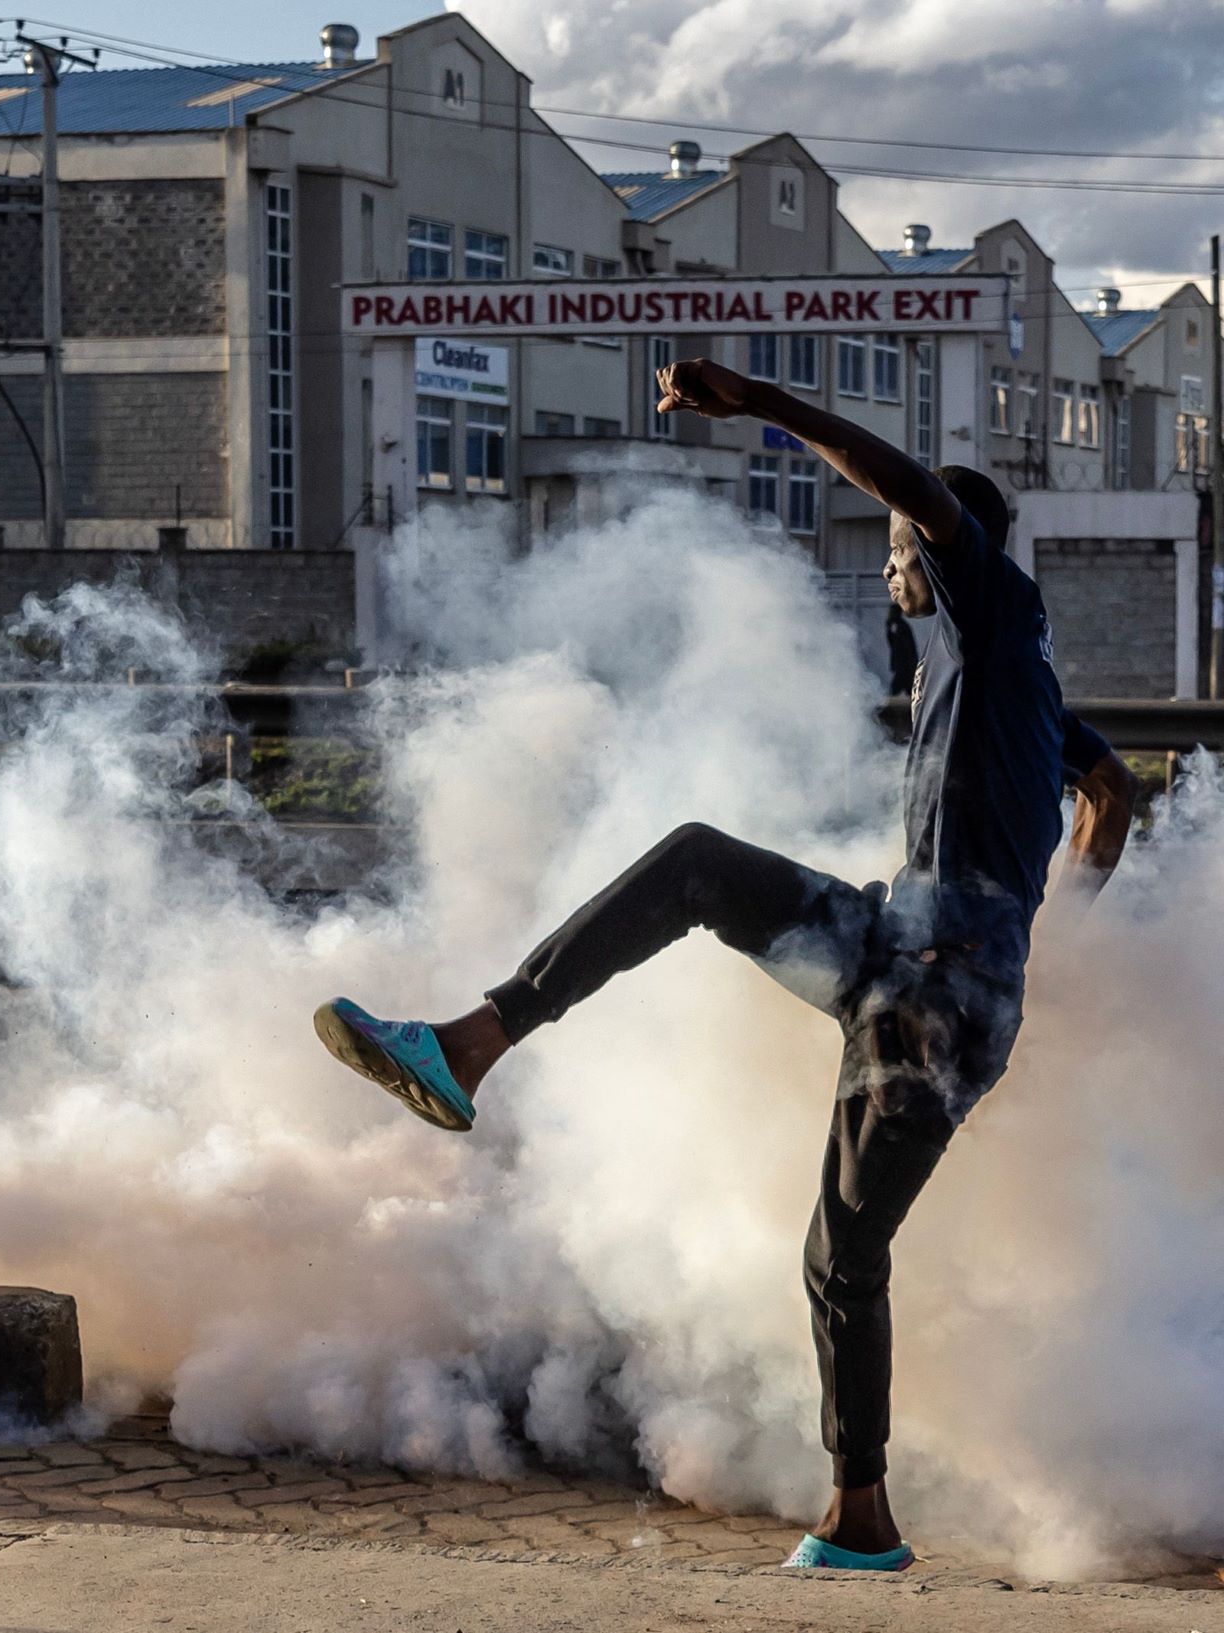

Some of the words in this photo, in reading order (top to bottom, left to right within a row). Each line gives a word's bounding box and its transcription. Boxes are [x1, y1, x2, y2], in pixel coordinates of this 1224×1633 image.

[352, 295, 534, 326] PRABHAKI
[549, 291, 773, 323] INDUSTRIAL
[785, 290, 881, 322] PARK
[893, 289, 980, 321] EXIT
